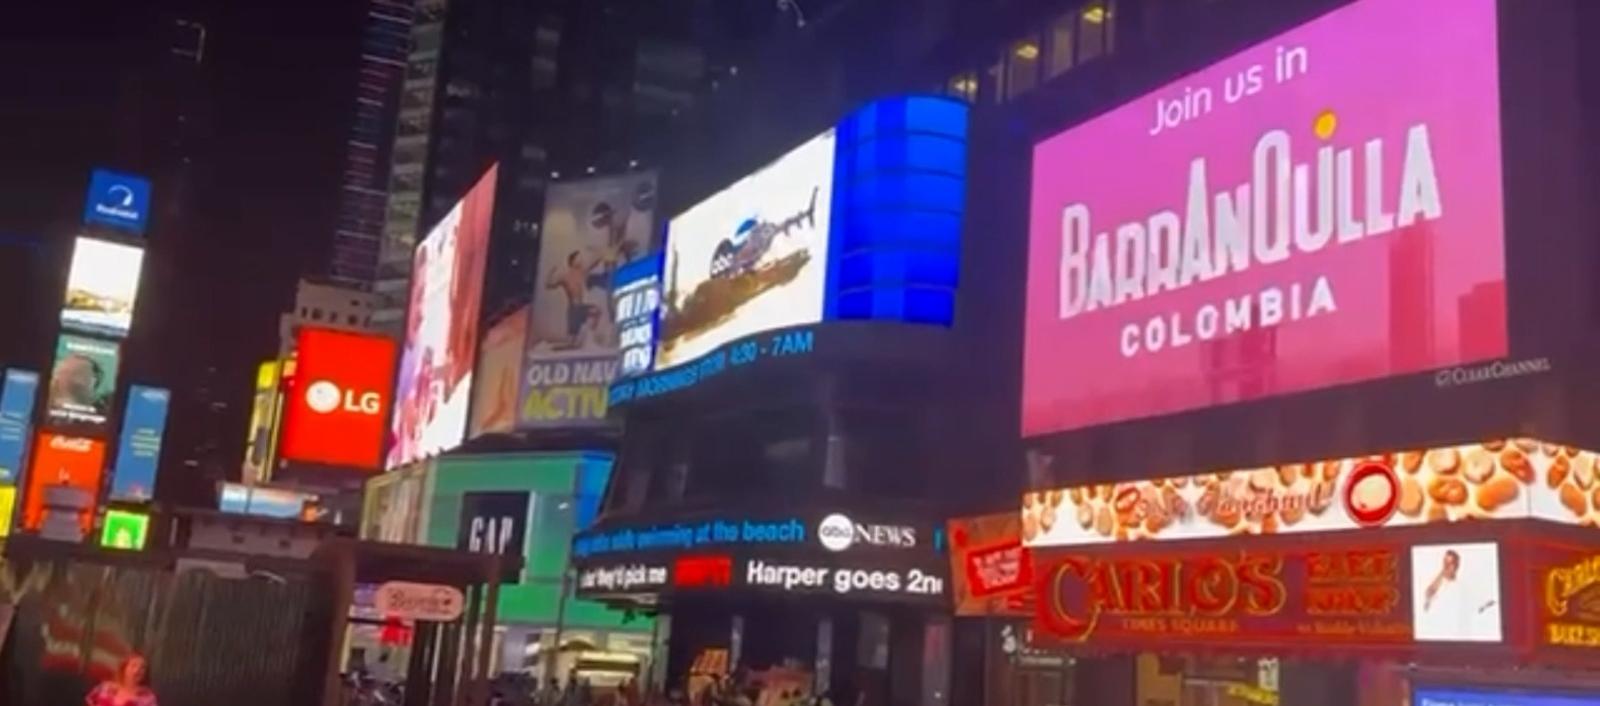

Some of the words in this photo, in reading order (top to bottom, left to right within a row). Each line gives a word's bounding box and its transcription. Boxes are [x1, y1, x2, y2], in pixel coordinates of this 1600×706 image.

[1150, 85, 1212, 135] Join
[1224, 65, 1264, 103] us
[1275, 44, 1308, 83] in
[1120, 276, 1337, 358] COLOMBIA
[527, 361, 570, 386] OLD
[572, 360, 617, 385] NAV
[343, 389, 381, 415] LG
[523, 385, 610, 420] ACTIV
[468, 516, 514, 555] GAP
[742, 518, 805, 543] beach
[854, 523, 917, 548] NEWS
[746, 559, 829, 590] Harper
[834, 567, 901, 594] goes
